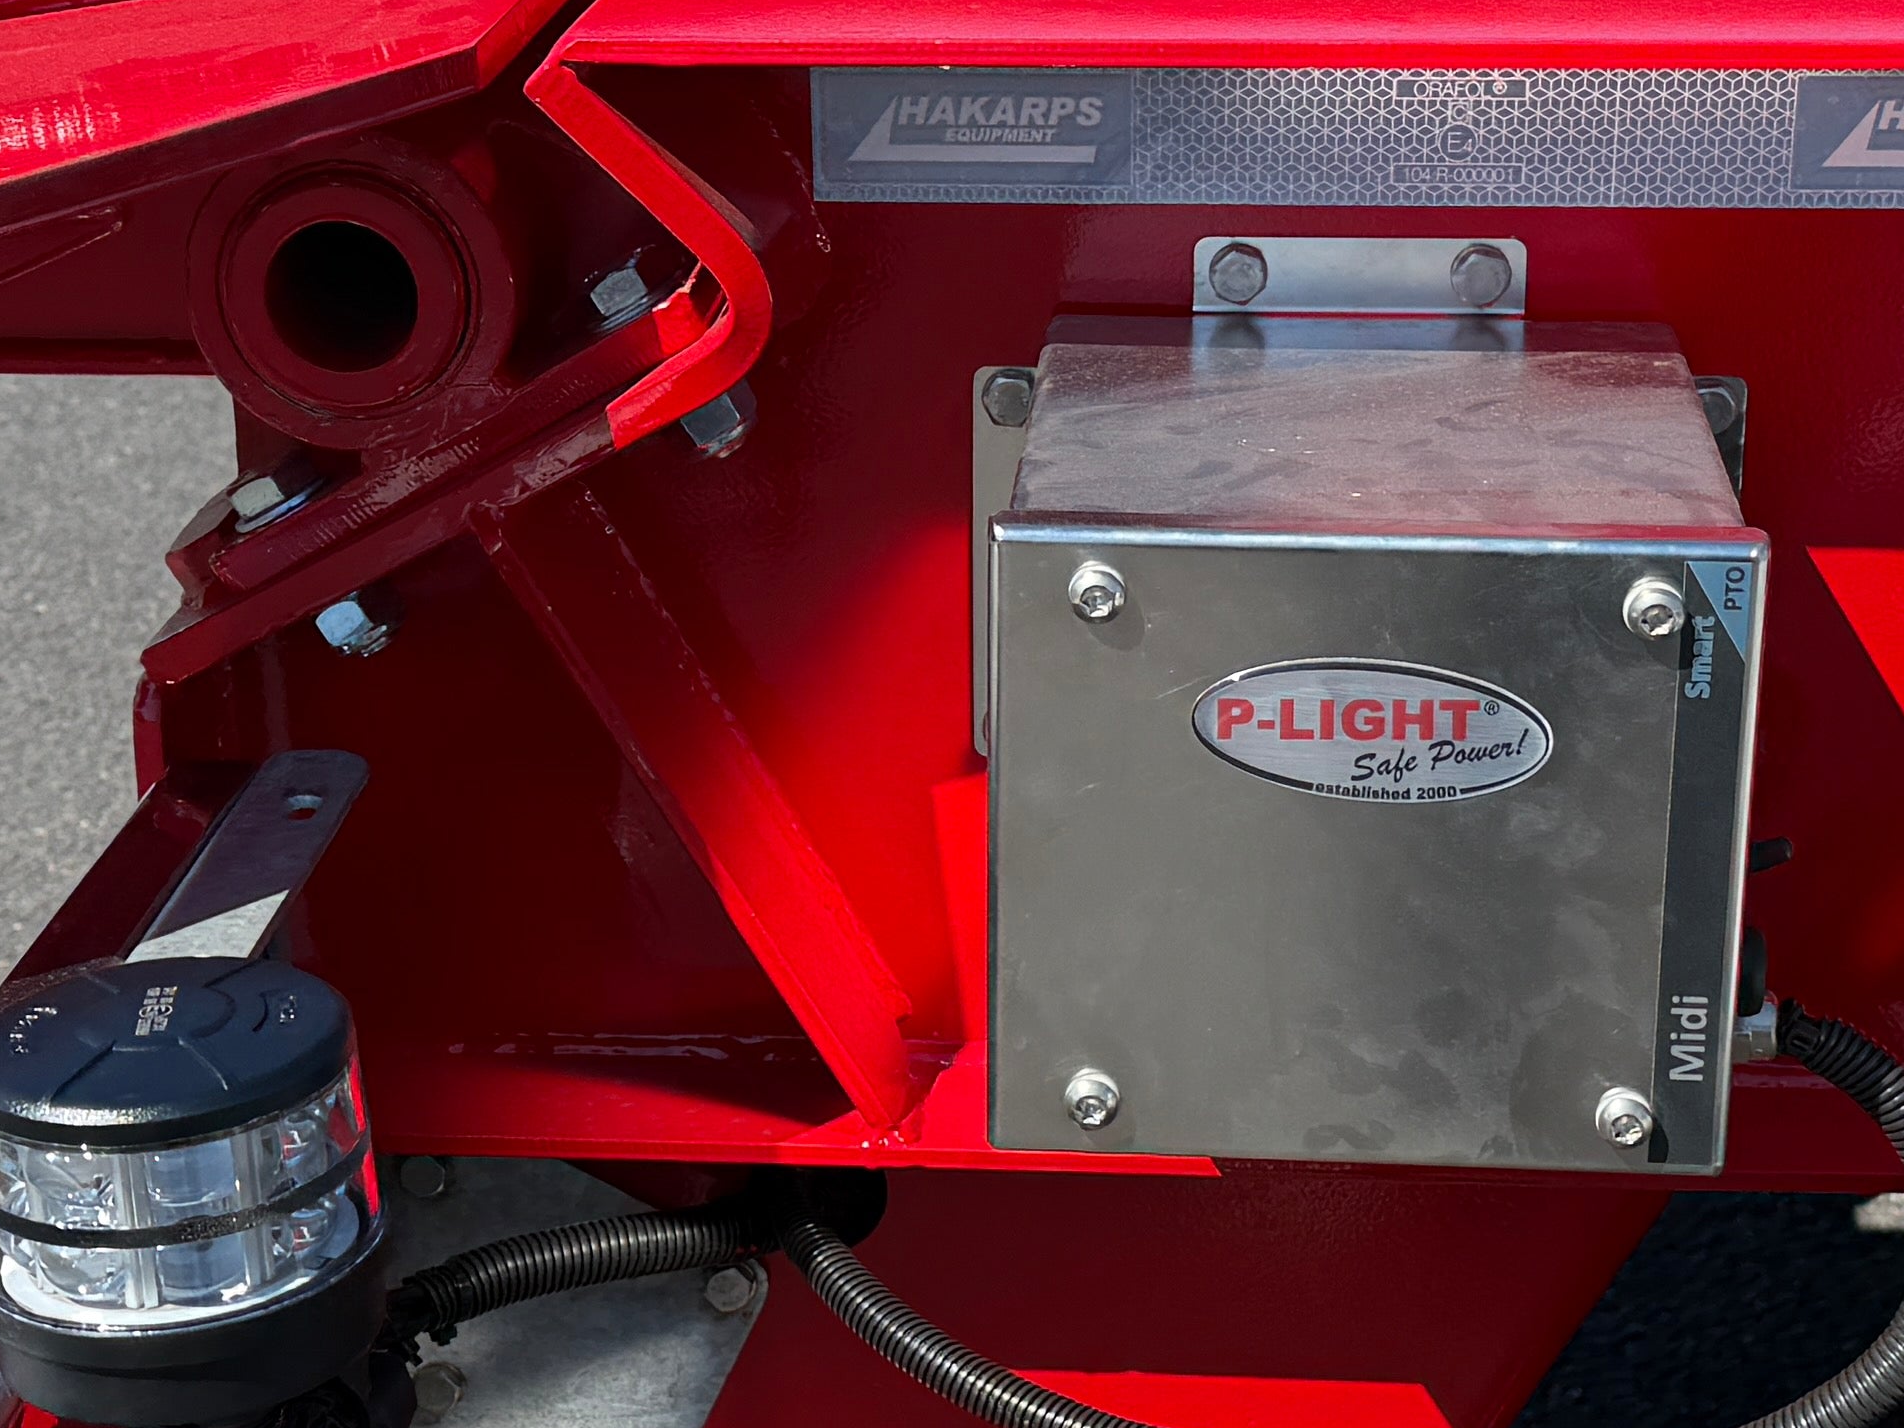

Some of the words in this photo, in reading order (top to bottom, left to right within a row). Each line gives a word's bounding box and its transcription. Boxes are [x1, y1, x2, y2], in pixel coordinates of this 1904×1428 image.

[897, 96, 1104, 126] HAKARPS
[945, 128, 1058, 144] EQUIPMENT
[1723, 566, 1746, 611] PTO
[1684, 615, 1716, 699] Smart
[1350, 748, 1418, 783] Safe
[1427, 727, 1532, 771] Power!
[1314, 781, 1412, 801] established
[1416, 785, 1458, 801] 2000
[1668, 995, 1709, 1082] Midi
